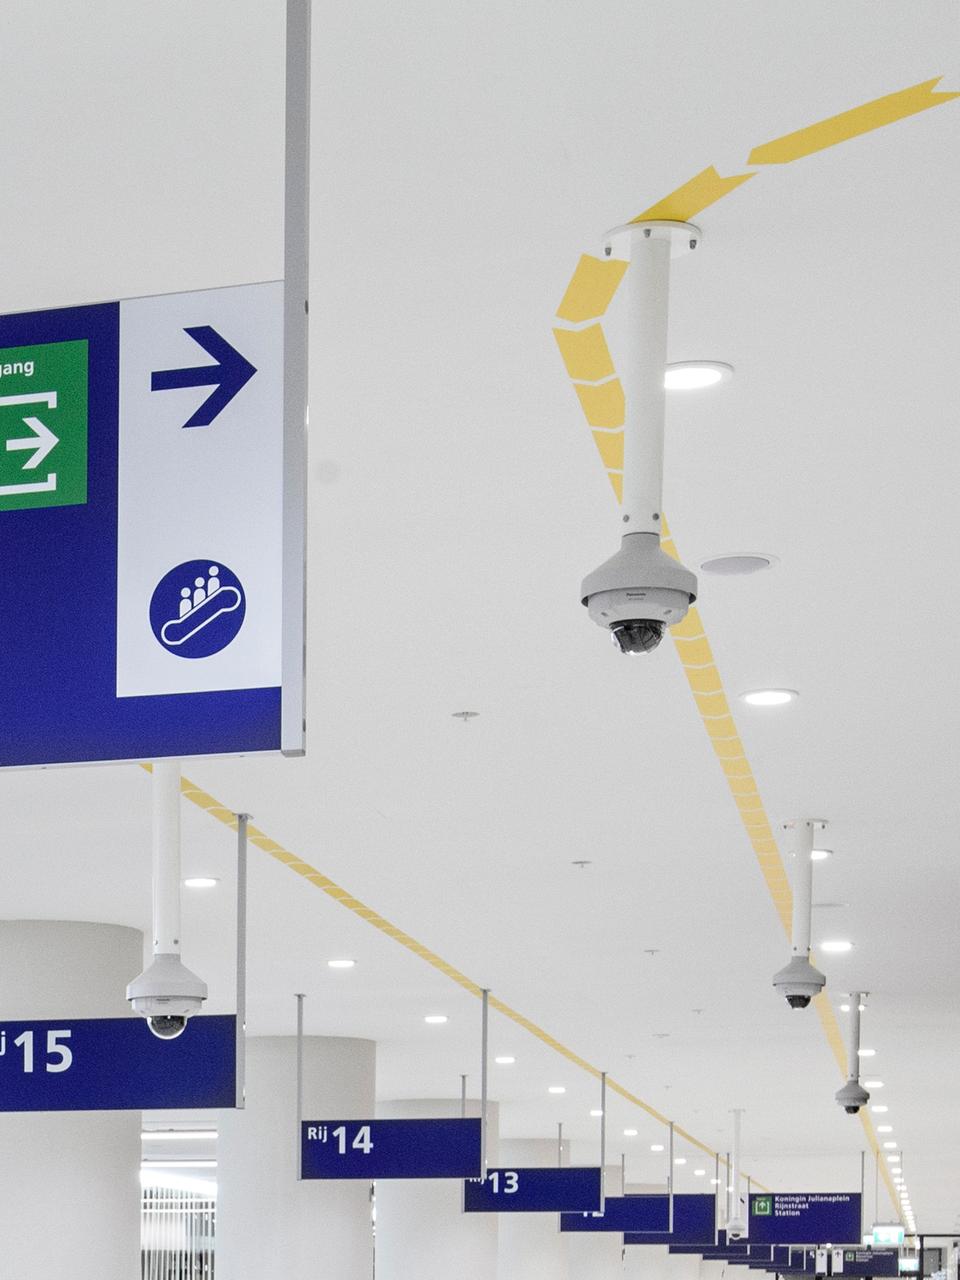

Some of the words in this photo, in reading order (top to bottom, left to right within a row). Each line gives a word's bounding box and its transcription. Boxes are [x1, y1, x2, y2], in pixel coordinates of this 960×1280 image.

[14, 1029, 73, 1073] 15
[307, 1126, 328, 1143] Rij
[332, 1125, 374, 1154] 14
[488, 1171, 519, 1194] 13
[774, 1195, 807, 1203] Koningin
[807, 1195, 850, 1204] Julianaplein
